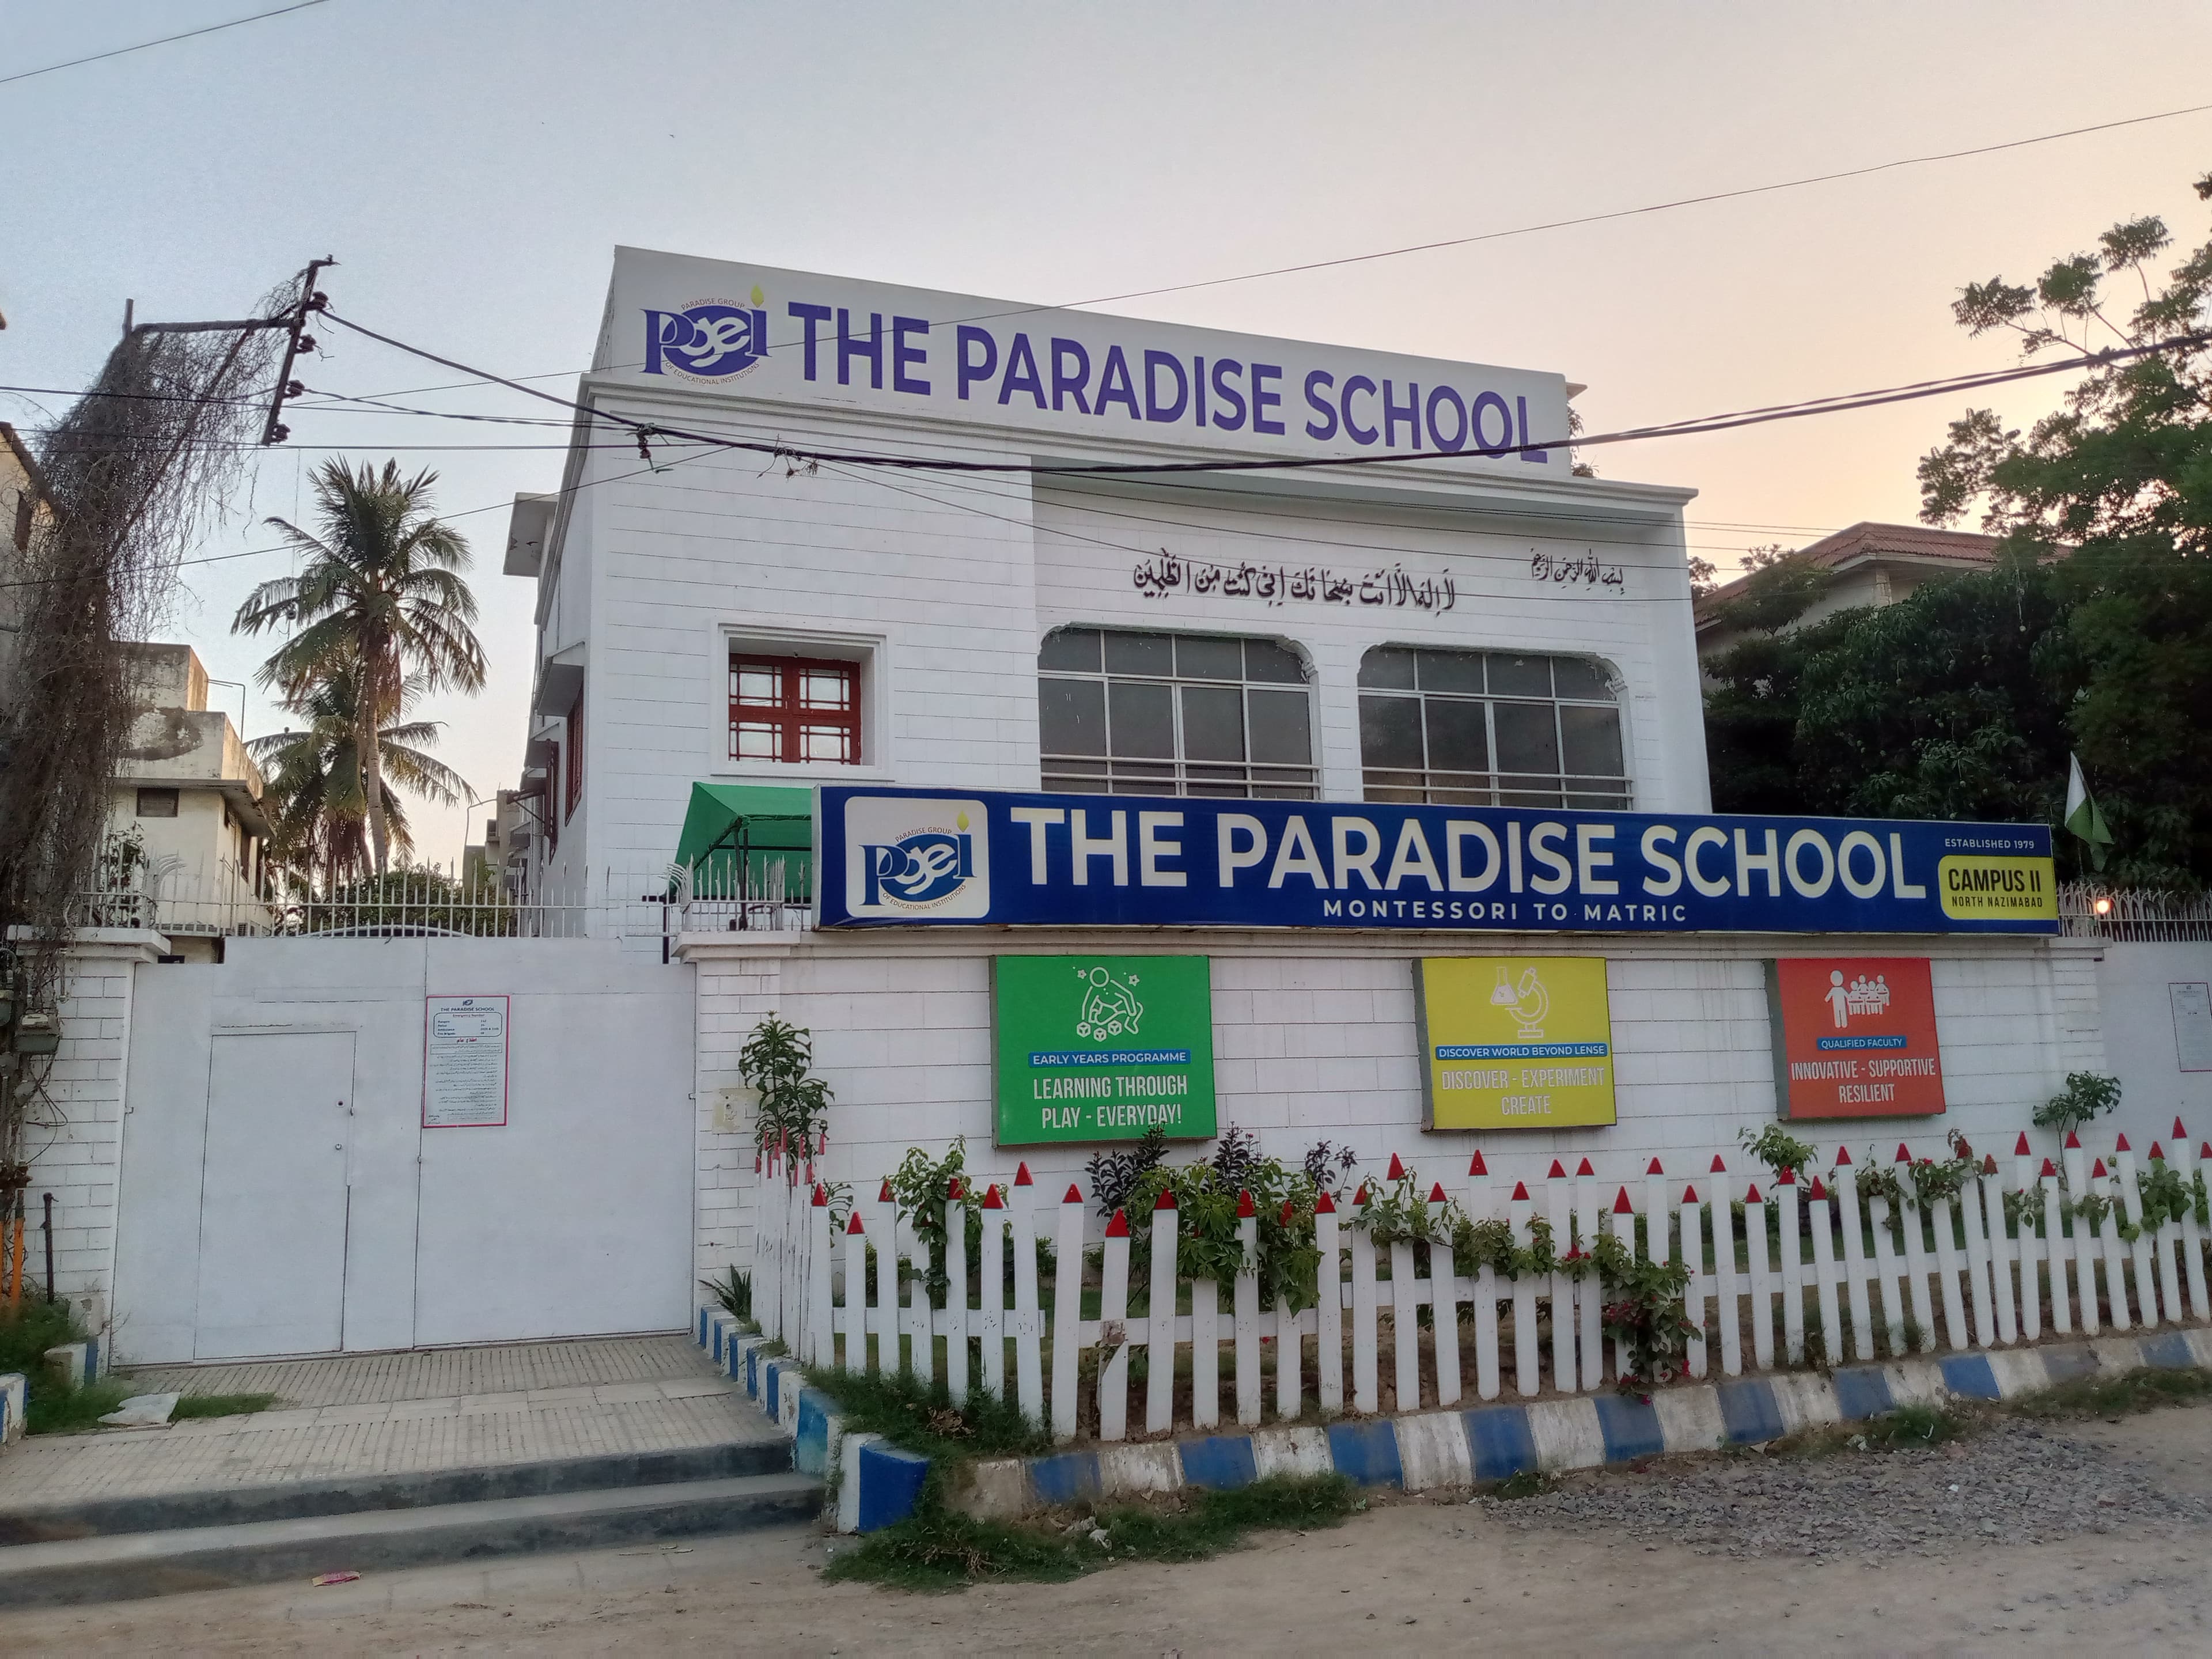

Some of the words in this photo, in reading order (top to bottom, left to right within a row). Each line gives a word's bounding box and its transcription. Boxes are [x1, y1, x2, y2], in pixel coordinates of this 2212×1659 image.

[681, 298, 715, 310] PARADISE
[717, 298, 745, 309] GROUP
[673, 369, 719, 385] EDUCATIONAL
[721, 362, 760, 384] INSTITUTIONS
[788, 301, 931, 396] THE
[957, 324, 1285, 435] PARADISE
[1304, 369, 1548, 464] SCHOOL
[895, 827, 926, 843] PARADISE
[927, 826, 952, 835] GROUP
[1945, 838, 2011, 849] ESTABLISHED
[2014, 840, 2035, 849] 1979
[1010, 806, 1188, 888] THE
[1217, 812, 1619, 895] PARADISE
[1641, 825, 1927, 899] SCHOOL
[1948, 868, 2025, 892] CAMPUS
[2029, 870, 2041, 892] II
[890, 897, 931, 910] EDUCATIONAL
[931, 884, 967, 908] INSTITUTIONS
[1952, 896, 1983, 907] NORTH
[1988, 896, 2043, 908] NAZIMABAD
[1324, 899, 1517, 920] MONTESSORI
[1533, 903, 1567, 921] TO
[1585, 904, 1687, 922] MATRIC
[1439, 1047, 1490, 1057] DISCOVER
[1492, 1047, 1529, 1056] WORLD
[1532, 1046, 1572, 1055] BEYOND
[1574, 1046, 1605, 1055] LENSE
[1821, 1039, 1865, 1050] QUALIFIED
[1868, 1039, 1902, 1048] FACULTY
[1033, 1054, 1069, 1065] EARLY
[1072, 1054, 1109, 1064] YEARS
[1112, 1052, 1187, 1063] PROGRAMME
[1791, 1060, 1858, 1081] INNOVATIVE
[1868, 1058, 1936, 1078] SUPPORTIVE
[1033, 1077, 1112, 1100] LEARNING
[1115, 1075, 1187, 1097] THROUGH
[1442, 1070, 1509, 1090] DISCOVER
[1522, 1067, 1605, 1088] EXPERIMENT
[1839, 1084, 1895, 1103] RESILIENT
[1041, 1107, 1081, 1129] PLAY
[1097, 1103, 1181, 1127] EVERYDAY!
[1501, 1095, 1551, 1116] CREATE
